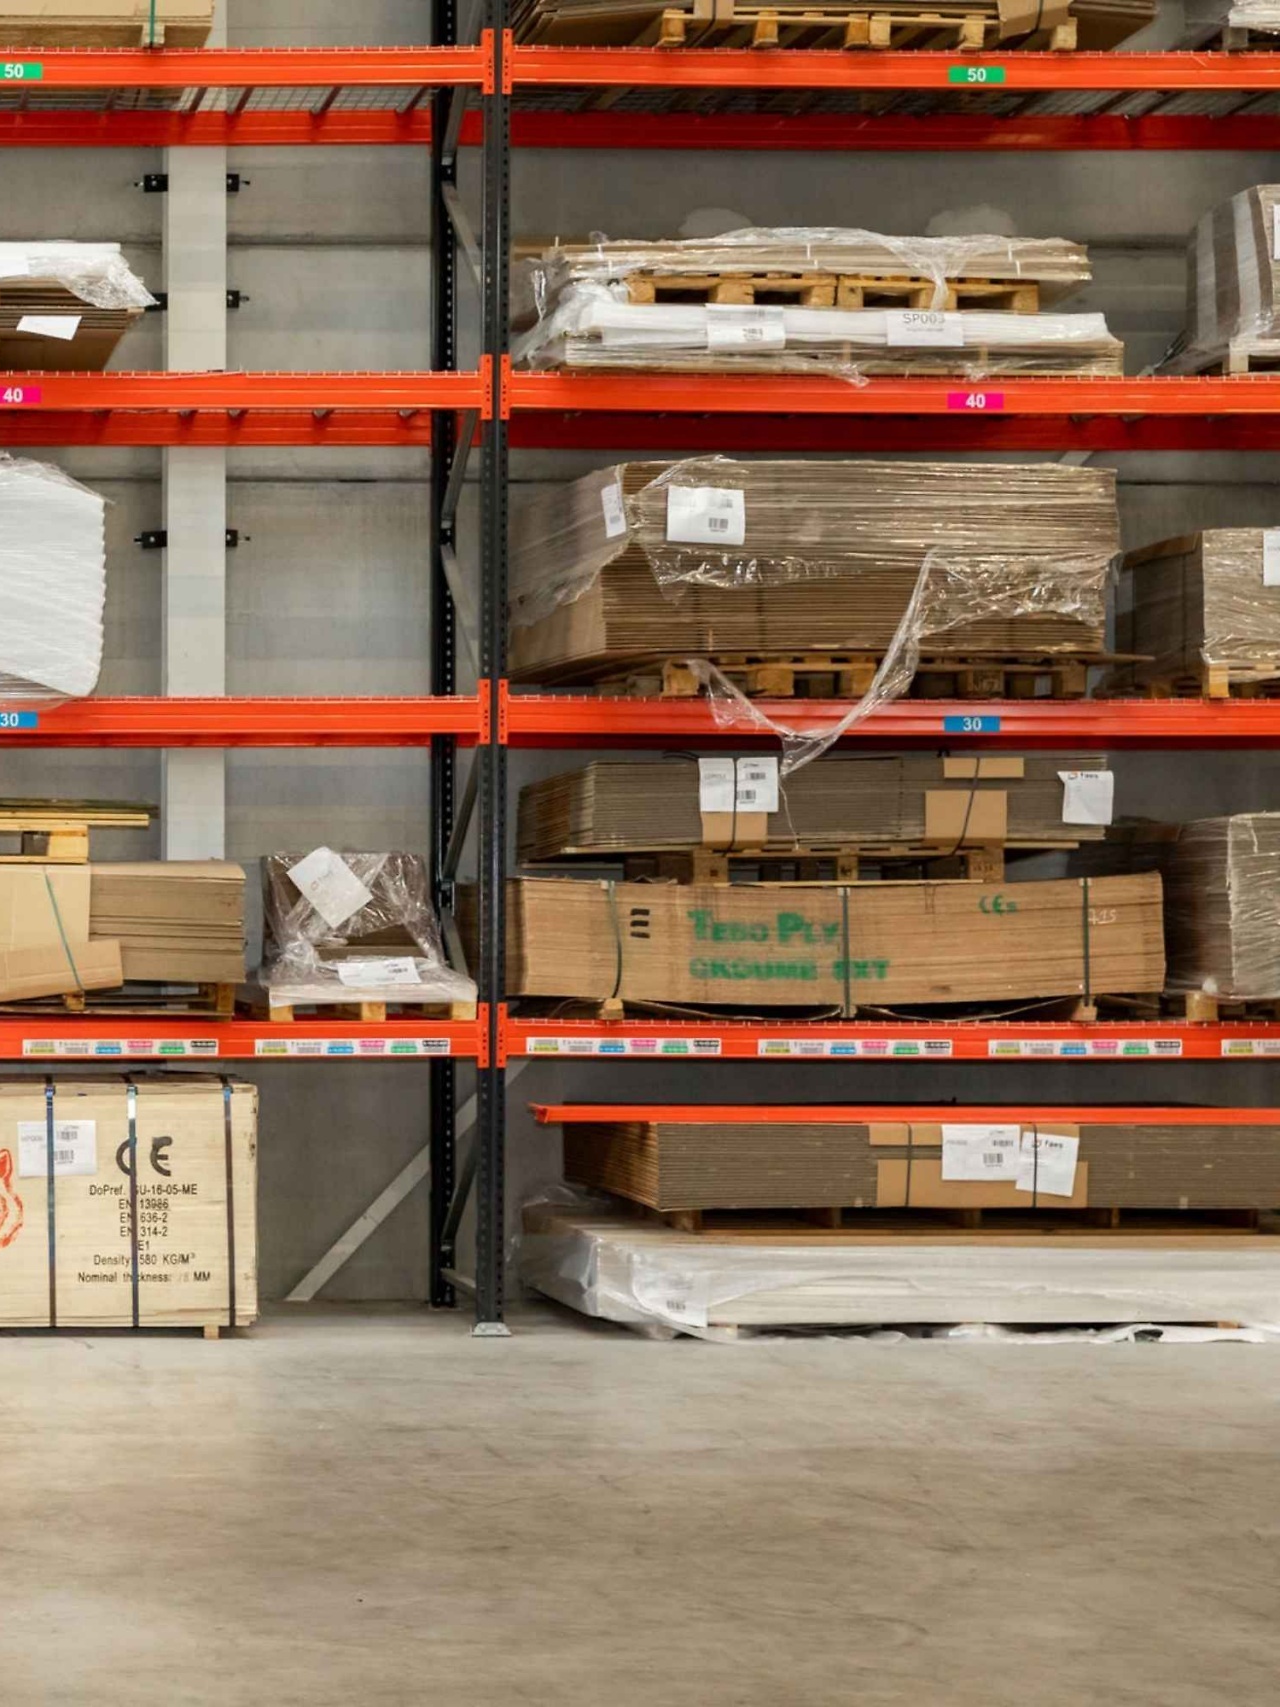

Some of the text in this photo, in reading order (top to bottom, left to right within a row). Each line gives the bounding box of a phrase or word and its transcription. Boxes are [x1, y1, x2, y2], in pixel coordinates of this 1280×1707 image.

[4, 64, 24, 79] 50
[967, 67, 987, 82] 50
[3, 388, 23, 403] 40
[965, 394, 986, 409] 40
[0, 712, 19, 728] 30
[962, 717, 982, 732] 30
[89, 1184, 126, 1196] DoPref.
[139, 1199, 169, 1210] 13986
[139, 1213, 168, 1224] 636-2
[139, 1227, 168, 1237] 314-2
[93, 1255, 132, 1267] Density
[139, 1254, 157, 1265] 580
[78, 1272, 117, 1283] Nominal
[123, 1272, 170, 1283] thkness:
[193, 1271, 211, 1282] MM
